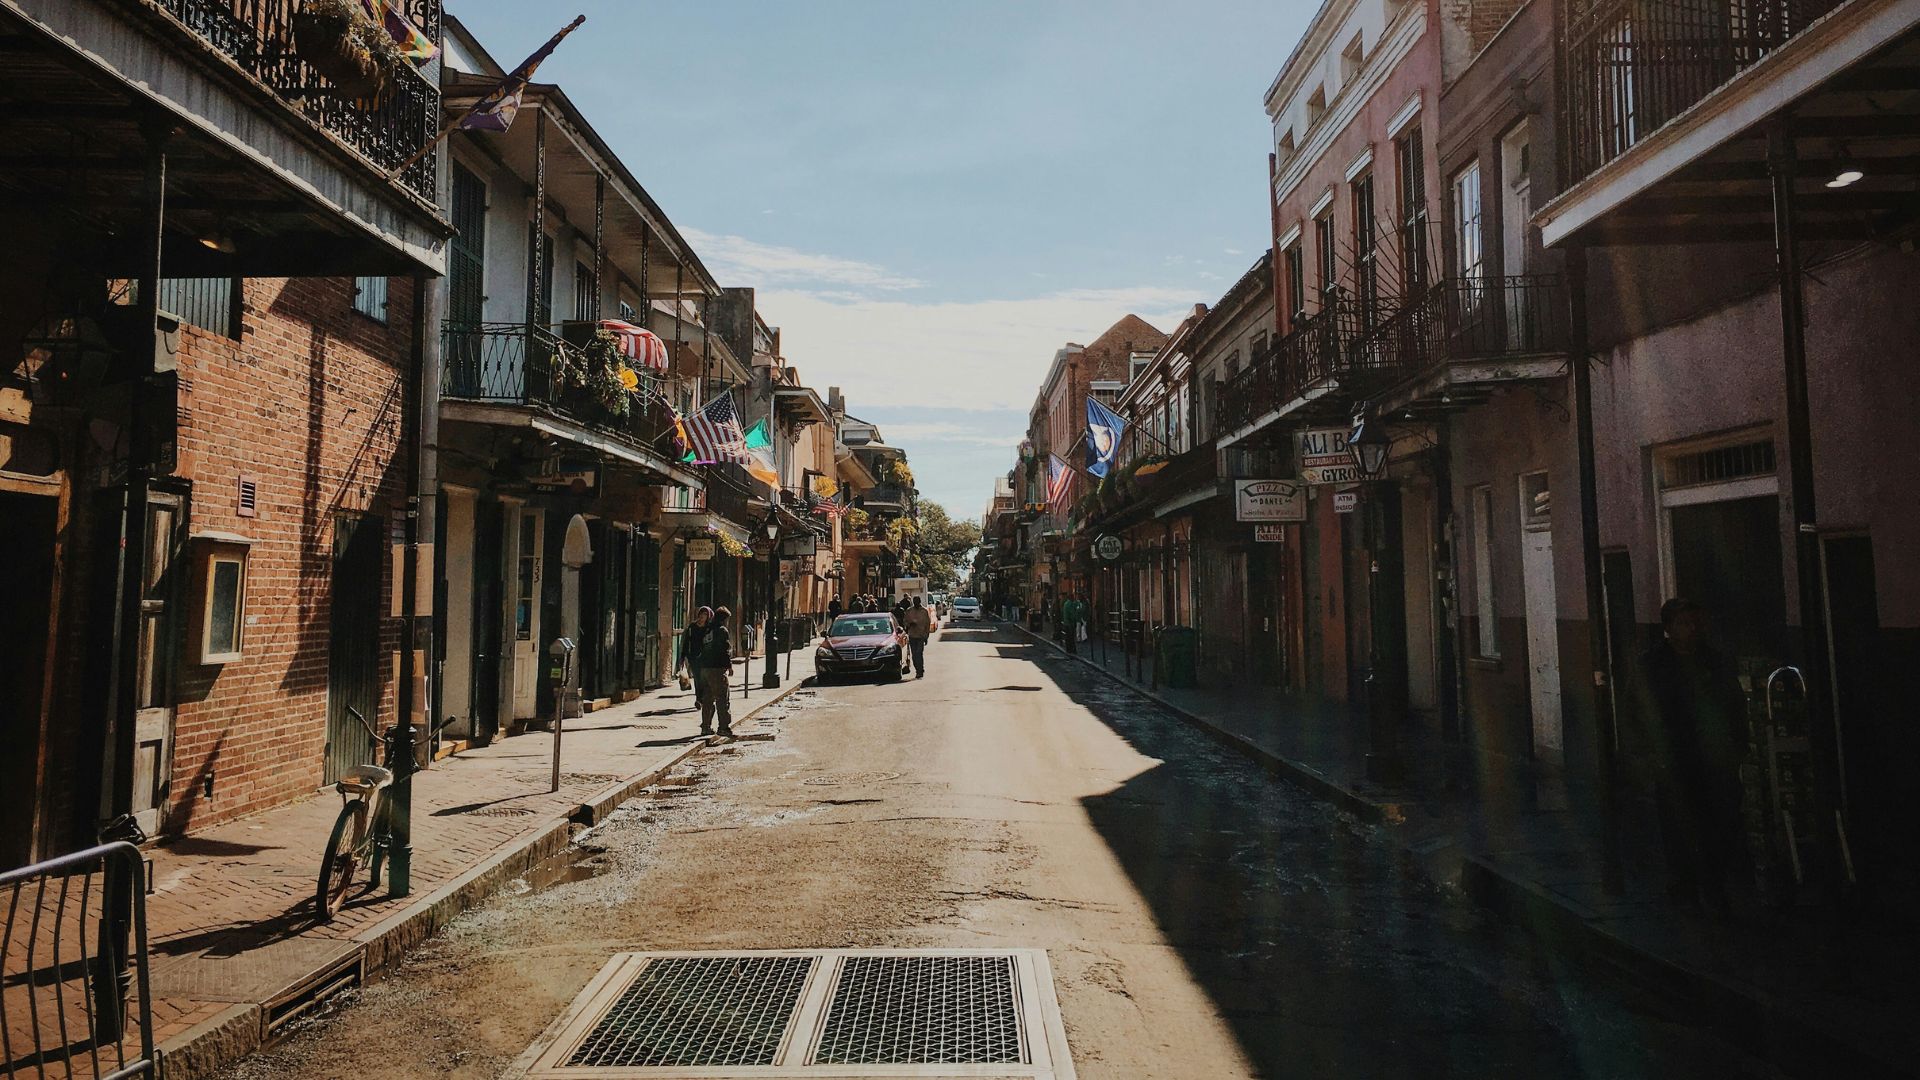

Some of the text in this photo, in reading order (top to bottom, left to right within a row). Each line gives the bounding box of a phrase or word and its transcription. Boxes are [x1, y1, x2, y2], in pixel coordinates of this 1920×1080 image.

[1302, 433, 1328, 455] ALI
[1304, 456, 1336, 467] RESTAURANT
[1256, 484, 1286, 492] PIZZA
[1259, 497, 1283, 505] DANTE
[1256, 525, 1283, 534] ATM
